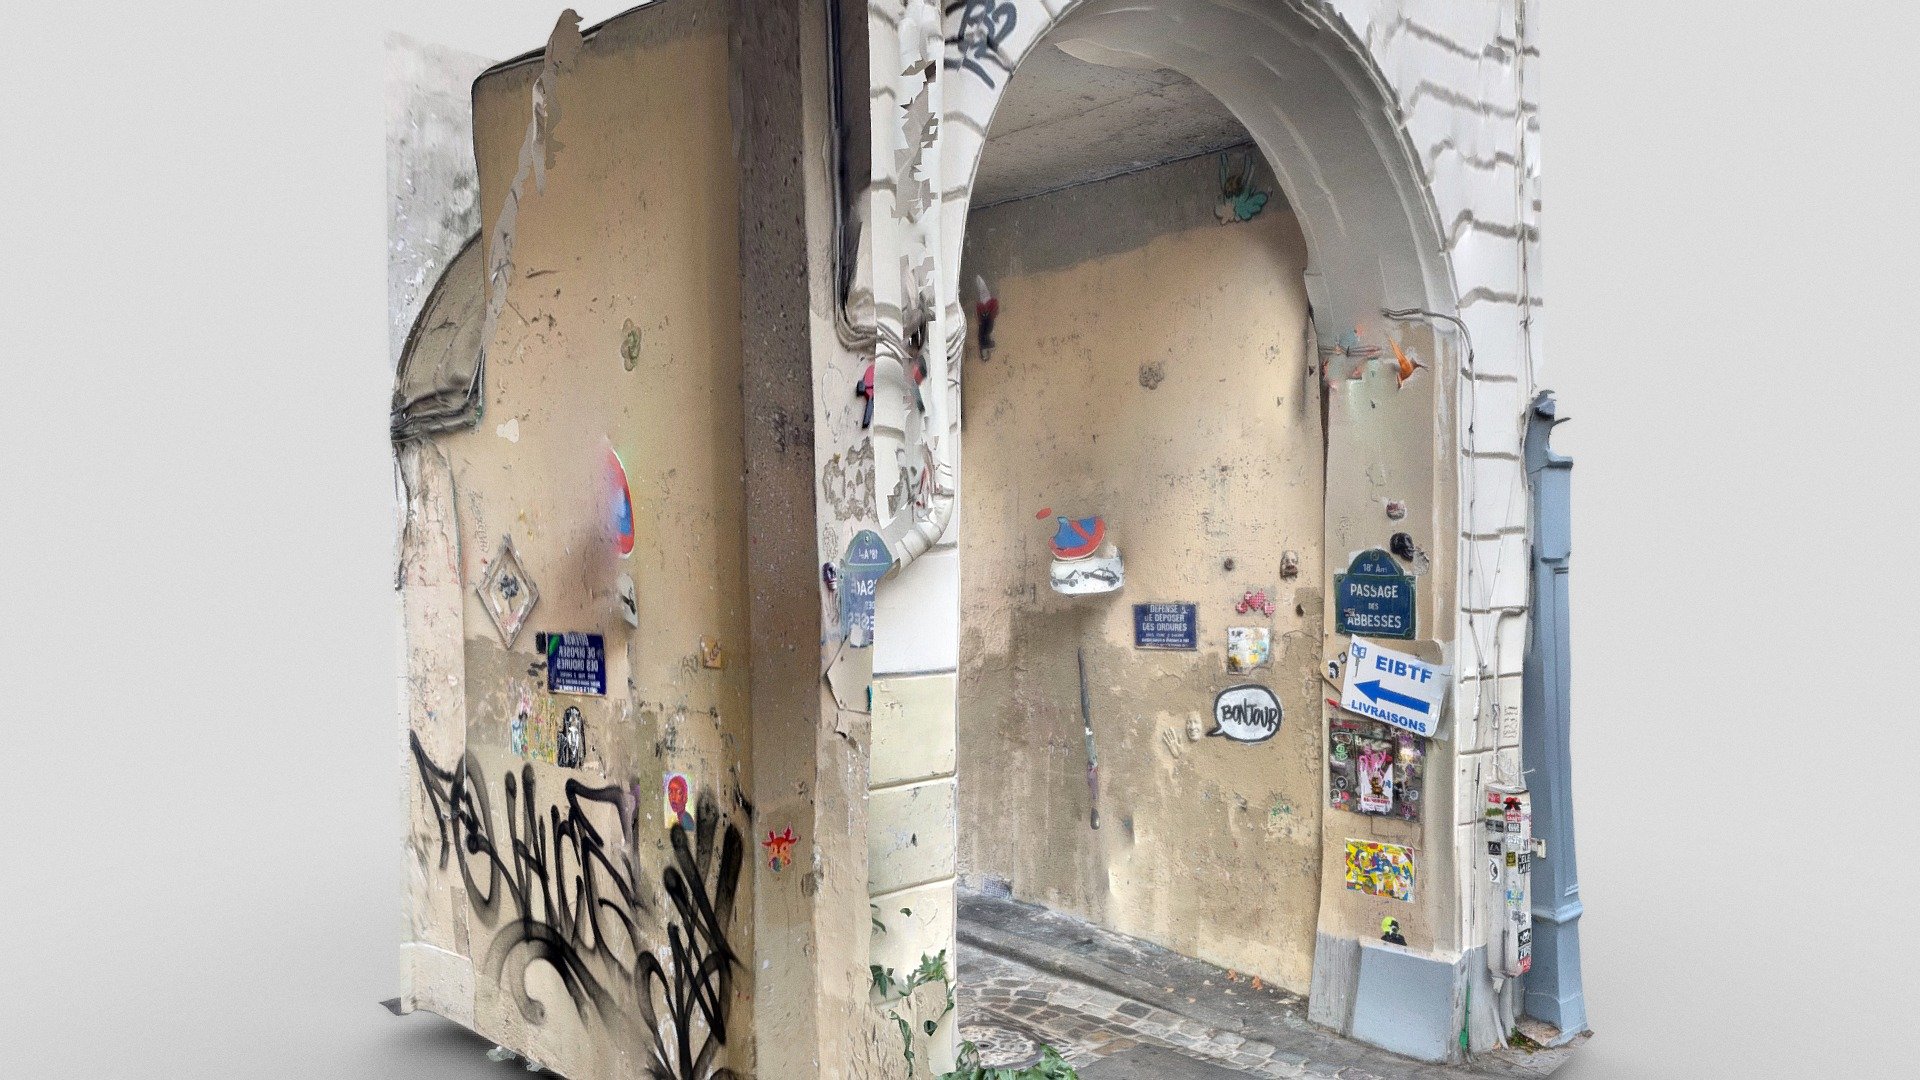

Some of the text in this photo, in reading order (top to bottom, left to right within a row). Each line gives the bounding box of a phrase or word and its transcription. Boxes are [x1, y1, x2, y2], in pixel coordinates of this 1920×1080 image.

[1350, 583, 1398, 598] PASSAGE
[1347, 614, 1402, 628] ABBESSES
[1375, 655, 1432, 683] EIBTF
[1221, 698, 1278, 732] BONJOUR
[1351, 699, 1427, 733] LIVRAISONS
